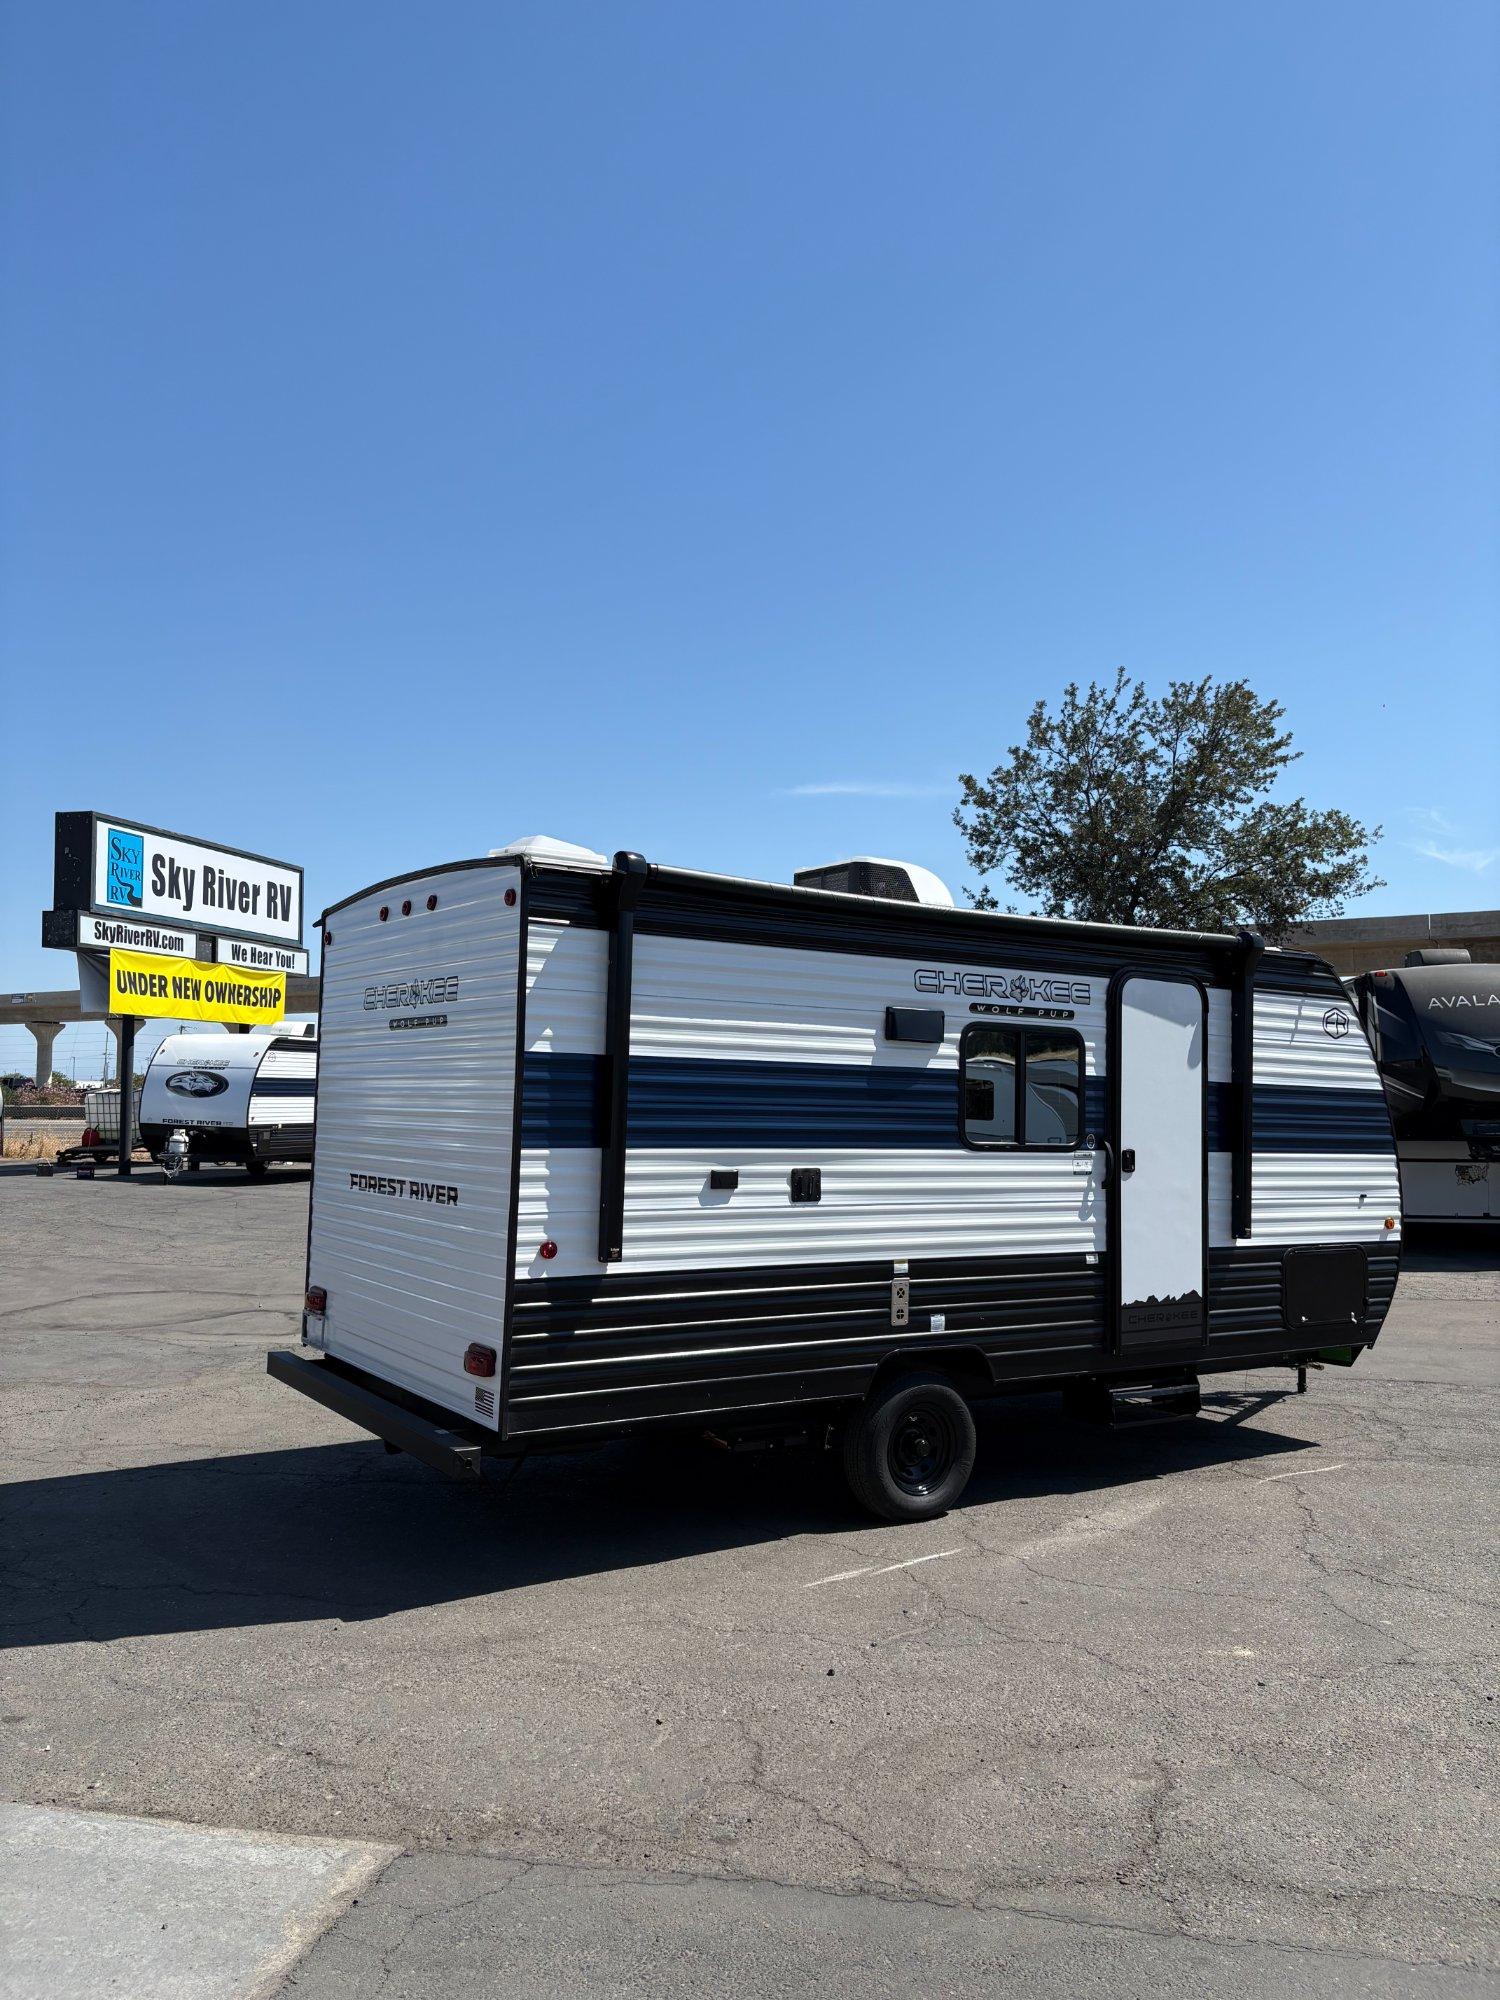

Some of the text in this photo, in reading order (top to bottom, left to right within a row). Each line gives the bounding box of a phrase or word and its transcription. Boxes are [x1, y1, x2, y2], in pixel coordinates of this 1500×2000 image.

[111, 836, 142, 865] SKY
[111, 861, 141, 881] RIVER
[110, 885, 128, 901] RV
[151, 853, 292, 922] Sky River RV
[94, 920, 184, 952] SkyRiverRV.com
[231, 943, 296, 970] We Hear You!
[116, 969, 282, 1009] UNDER NEW OWNERSHIP
[1428, 994, 1500, 1010] AVALA
[425, 1016, 445, 1026] PUP
[976, 1004, 1069, 1019] WOLF PUP
[349, 1172, 459, 1206] FOREST RIVER
